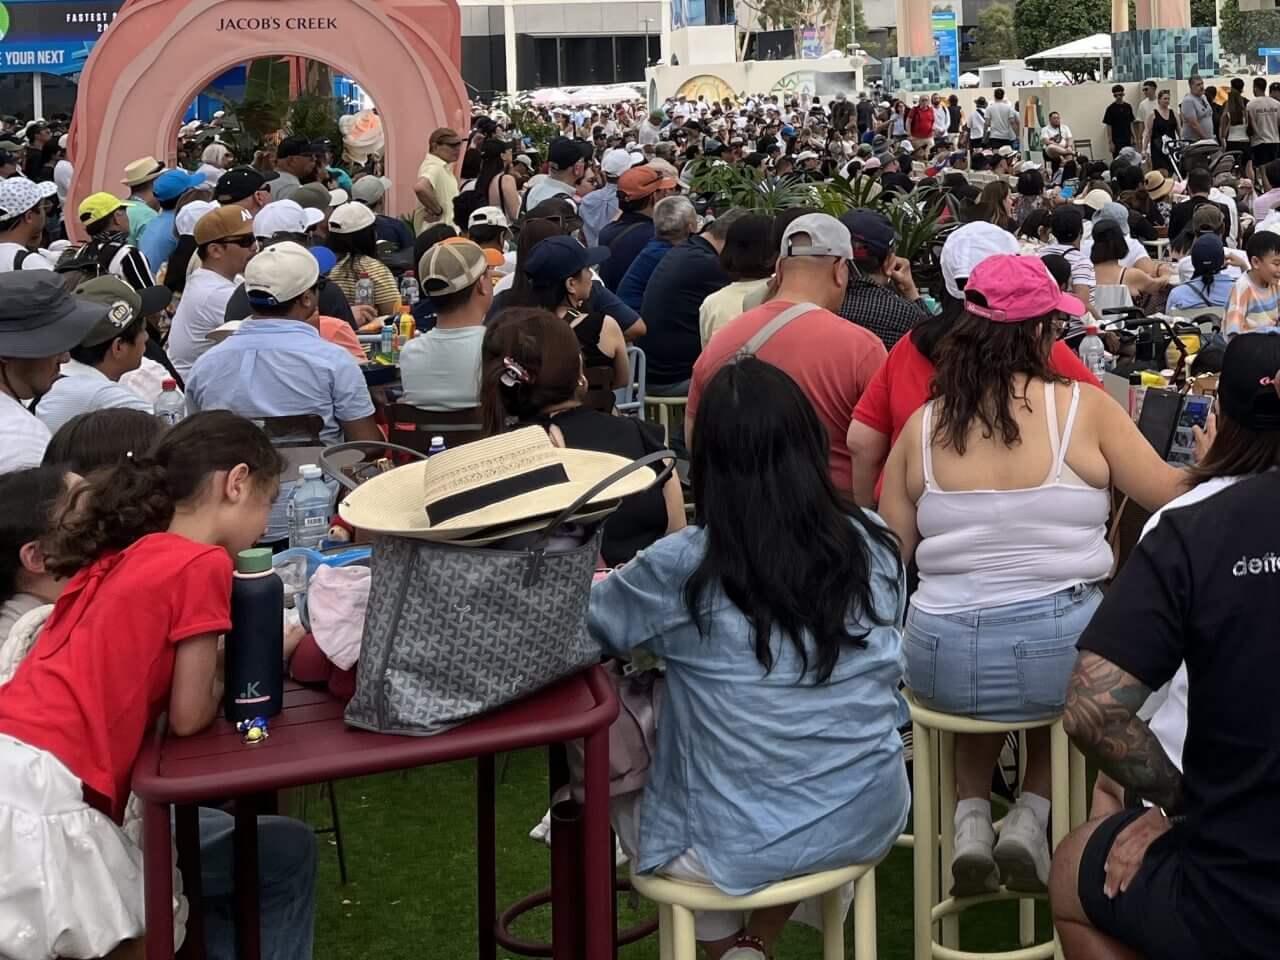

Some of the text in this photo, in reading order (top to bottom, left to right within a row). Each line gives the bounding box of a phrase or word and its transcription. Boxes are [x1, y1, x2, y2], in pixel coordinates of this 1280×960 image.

[66, 12, 108, 23] FASTEST
[216, 16, 338, 32] JACOB'S CREEK
[5, 51, 35, 65] YOUR
[37, 49, 64, 64] NEXT
